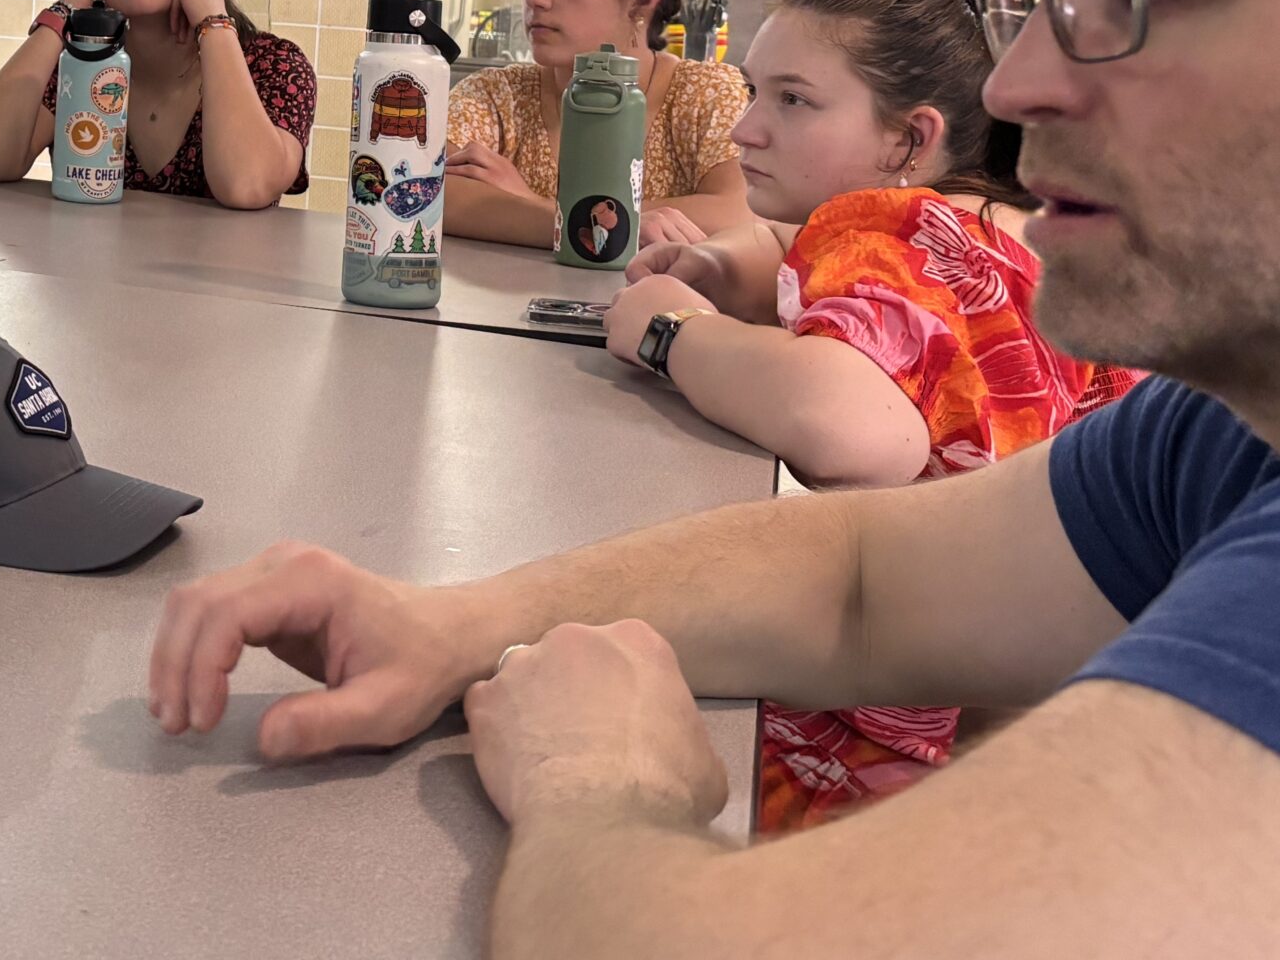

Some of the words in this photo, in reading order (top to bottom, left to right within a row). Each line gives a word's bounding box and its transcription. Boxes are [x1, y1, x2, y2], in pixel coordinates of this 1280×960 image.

[86, 111, 100, 123] THE
[66, 166, 91, 180] LAKE
[353, 232, 369, 241] YOU
[24, 372, 42, 390] UC
[17, 393, 46, 419] SANTA
